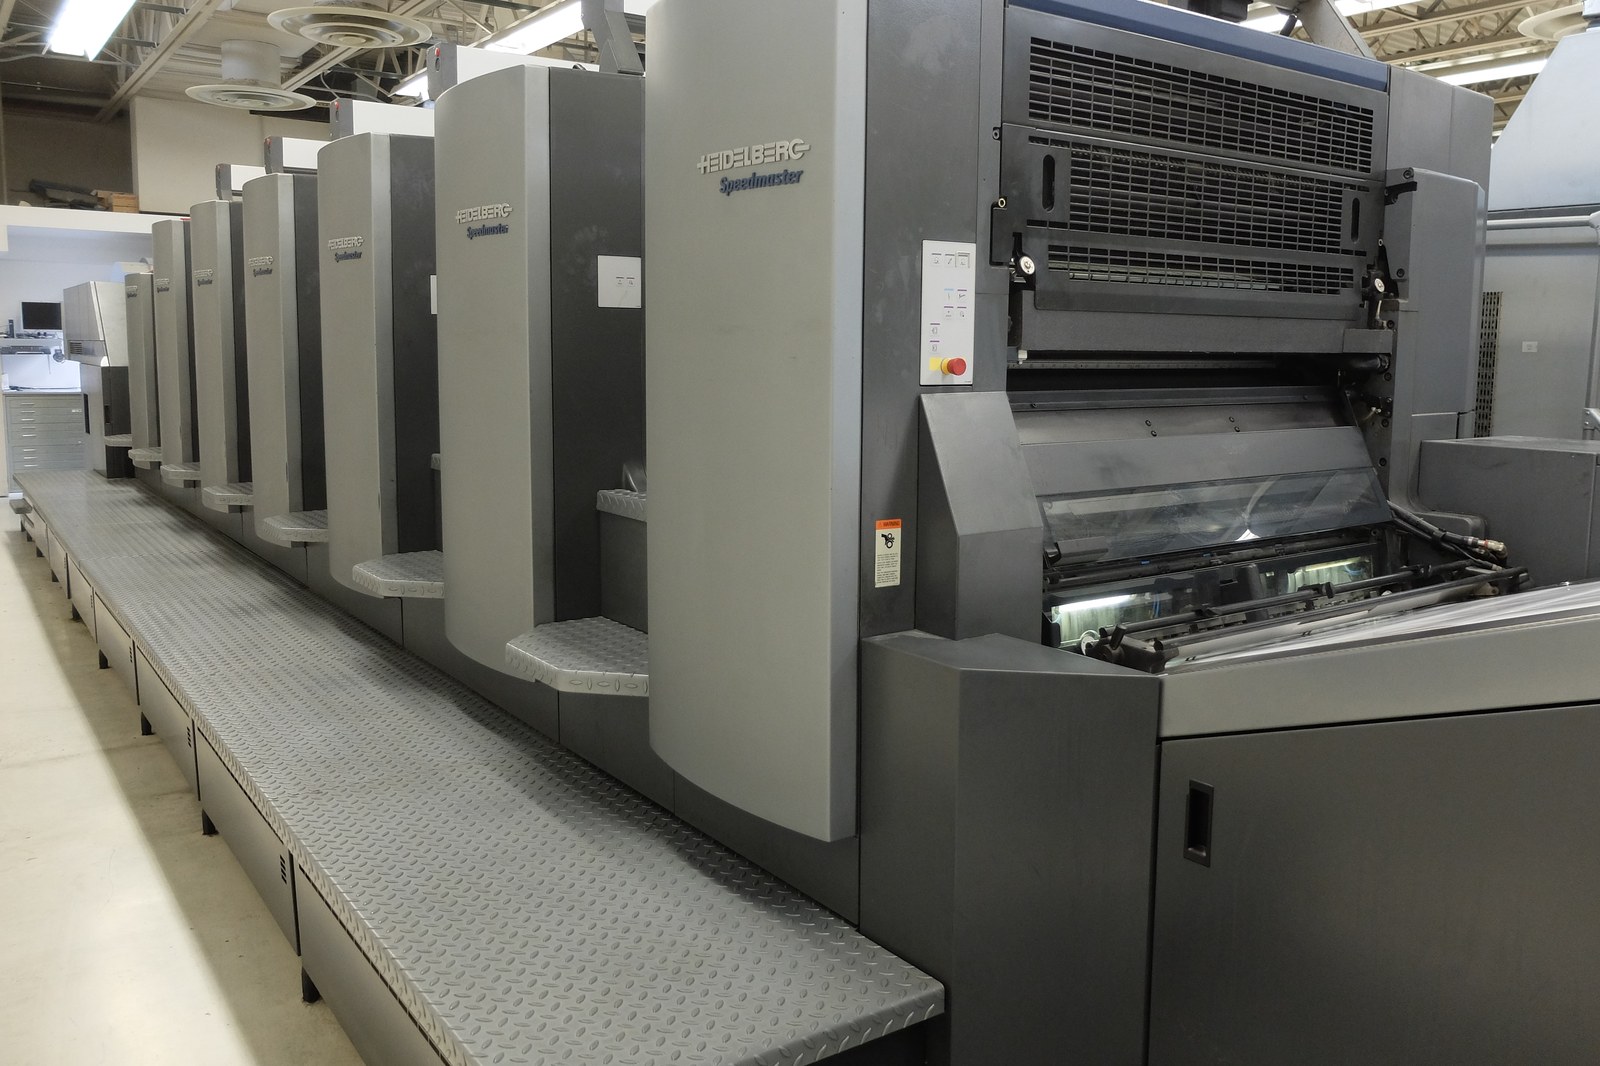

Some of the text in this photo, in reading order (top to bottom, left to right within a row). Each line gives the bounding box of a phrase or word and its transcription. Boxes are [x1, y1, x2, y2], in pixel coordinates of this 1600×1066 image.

[697, 138, 811, 174] HEIDELBERG
[719, 169, 804, 196] Speedmaster
[456, 203, 513, 224] HEIDELBERG
[467, 223, 509, 240] Speedmaster
